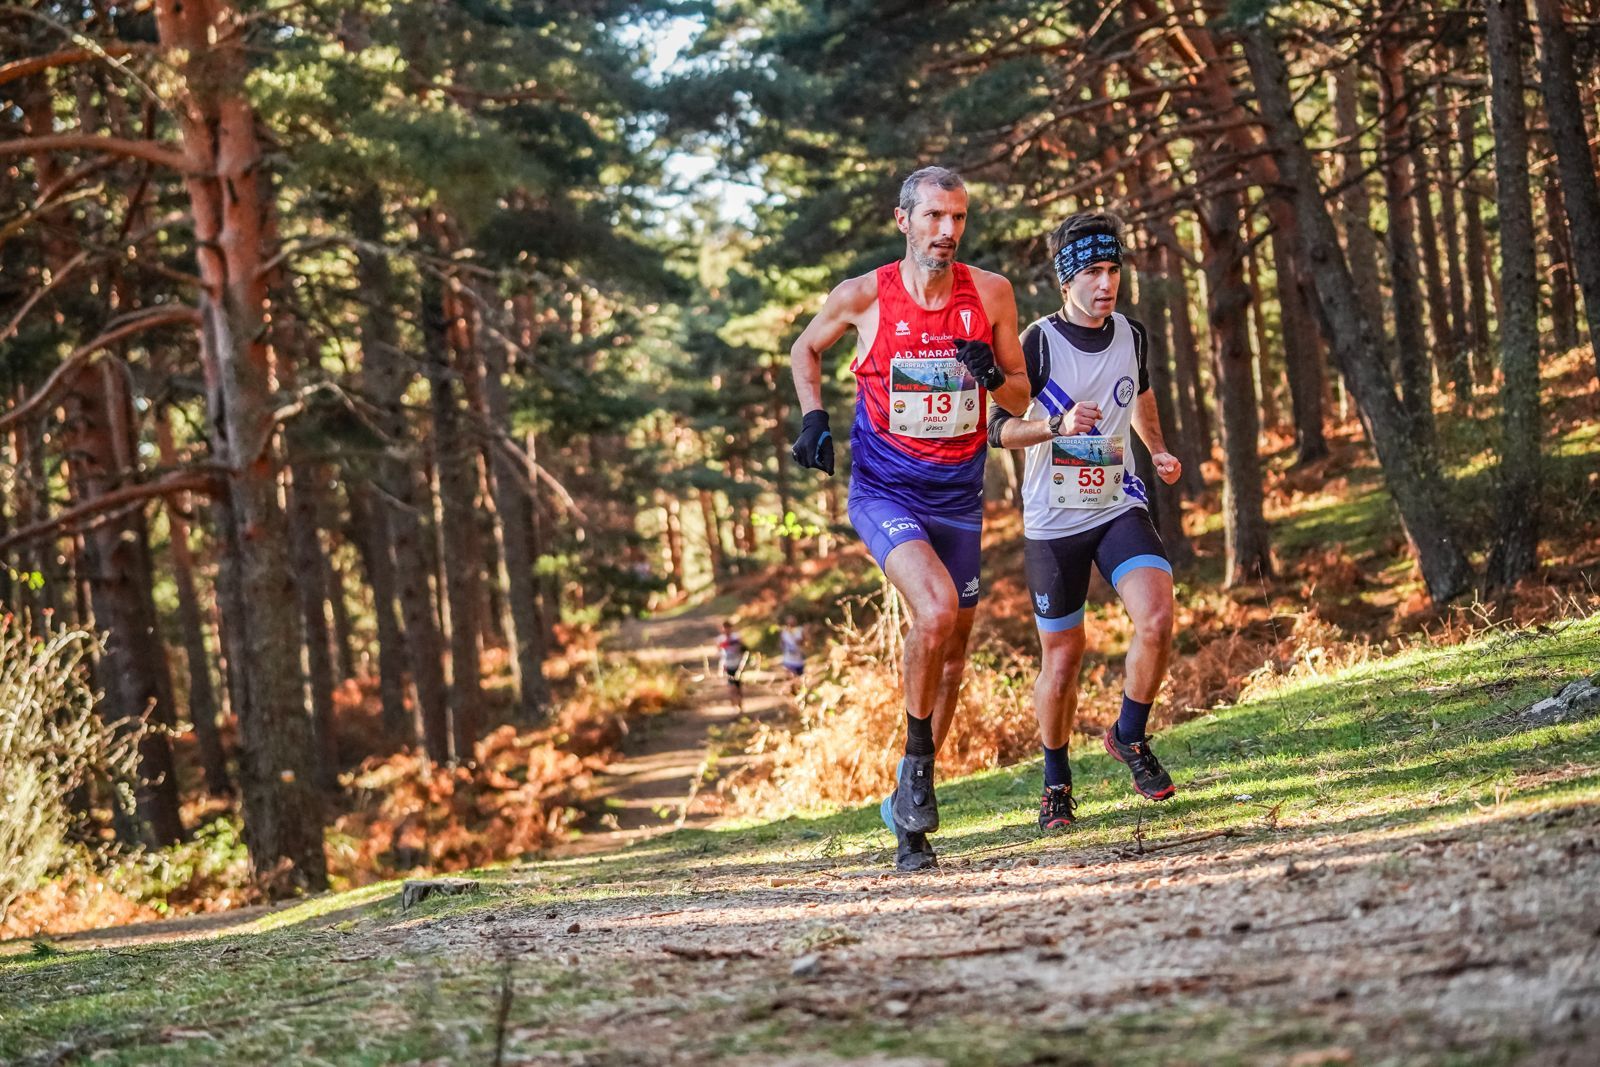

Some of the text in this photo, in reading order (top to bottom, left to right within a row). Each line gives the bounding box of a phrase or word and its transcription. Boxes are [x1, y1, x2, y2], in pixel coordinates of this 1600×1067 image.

[895, 351, 915, 359] A.D.
[923, 394, 952, 414] 13
[1078, 468, 1105, 487] 53
[889, 523, 921, 536] ADM
